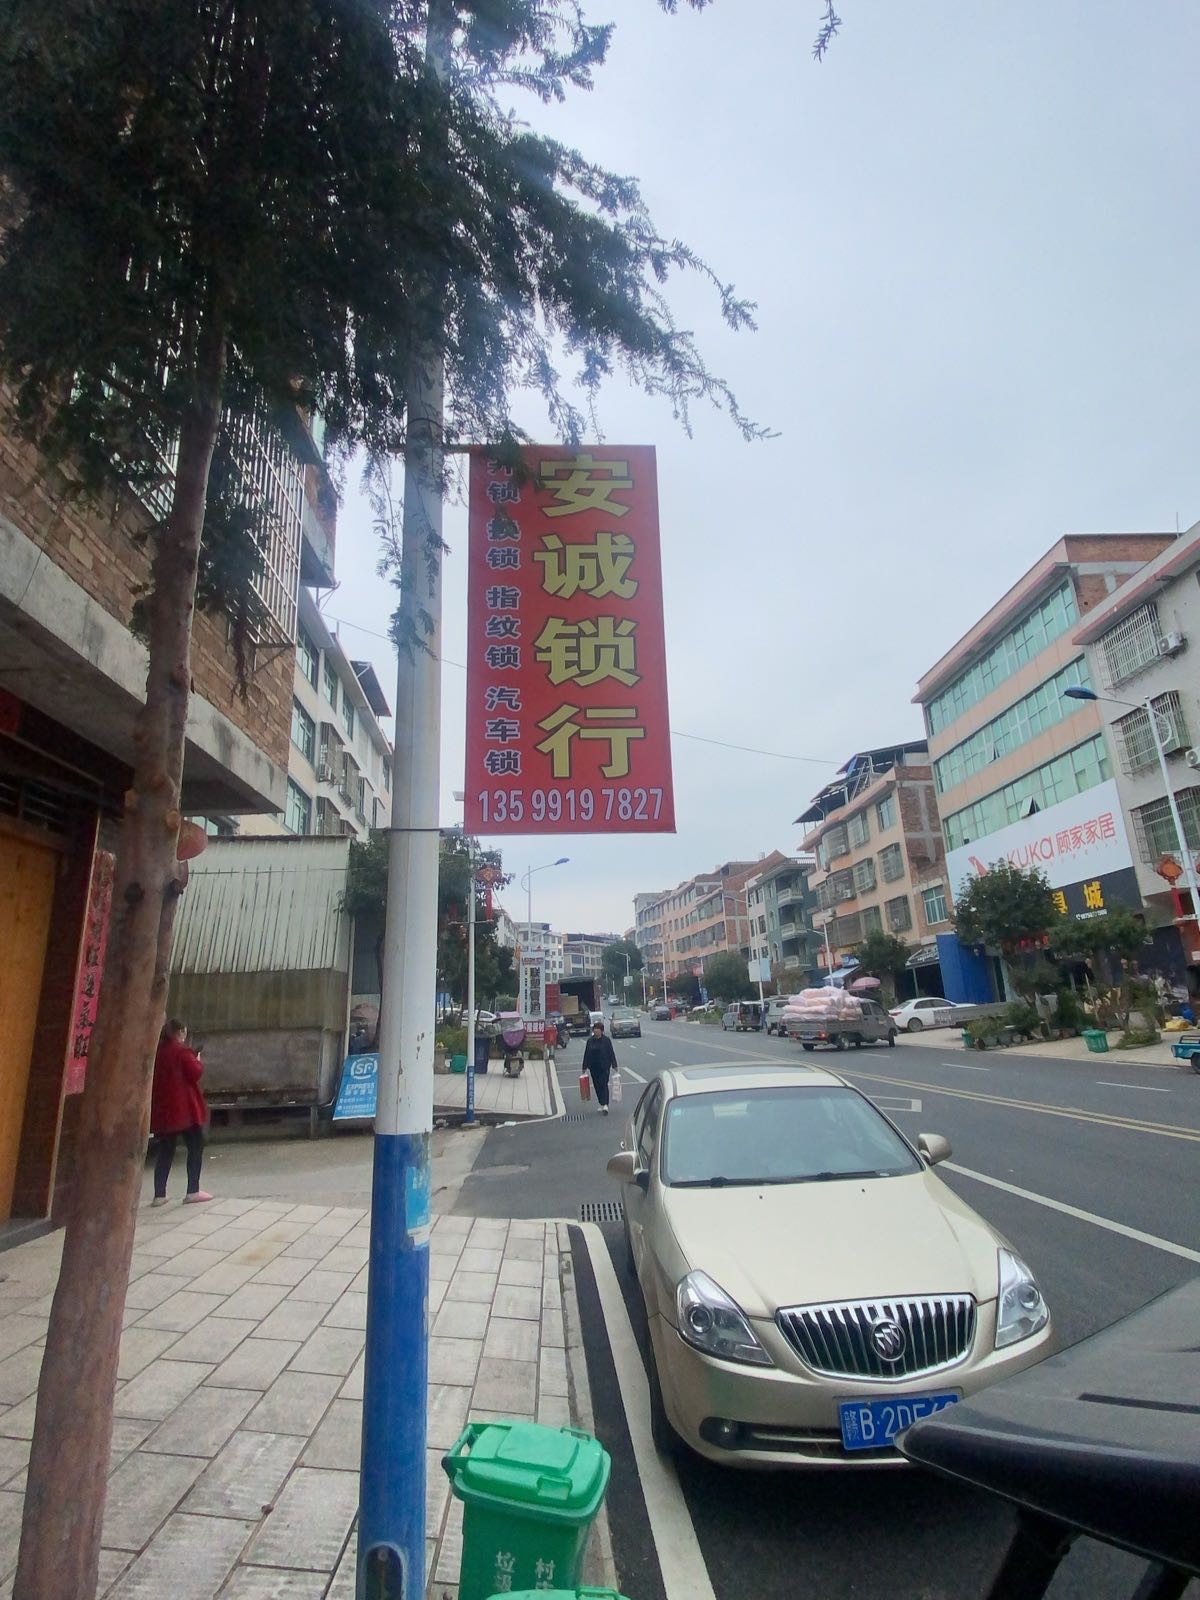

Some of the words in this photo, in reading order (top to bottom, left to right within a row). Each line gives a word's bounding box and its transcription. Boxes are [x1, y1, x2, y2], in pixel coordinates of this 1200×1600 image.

[485, 586, 521, 671] 指纹锁
[533, 453, 645, 779] 安诚锁行
[485, 686, 522, 776] 汽车锁
[478, 789, 522, 822] 135
[531, 788, 594, 822] 9919
[602, 787, 663, 821] 7827
[1056, 812, 1116, 855] 顾家家居
